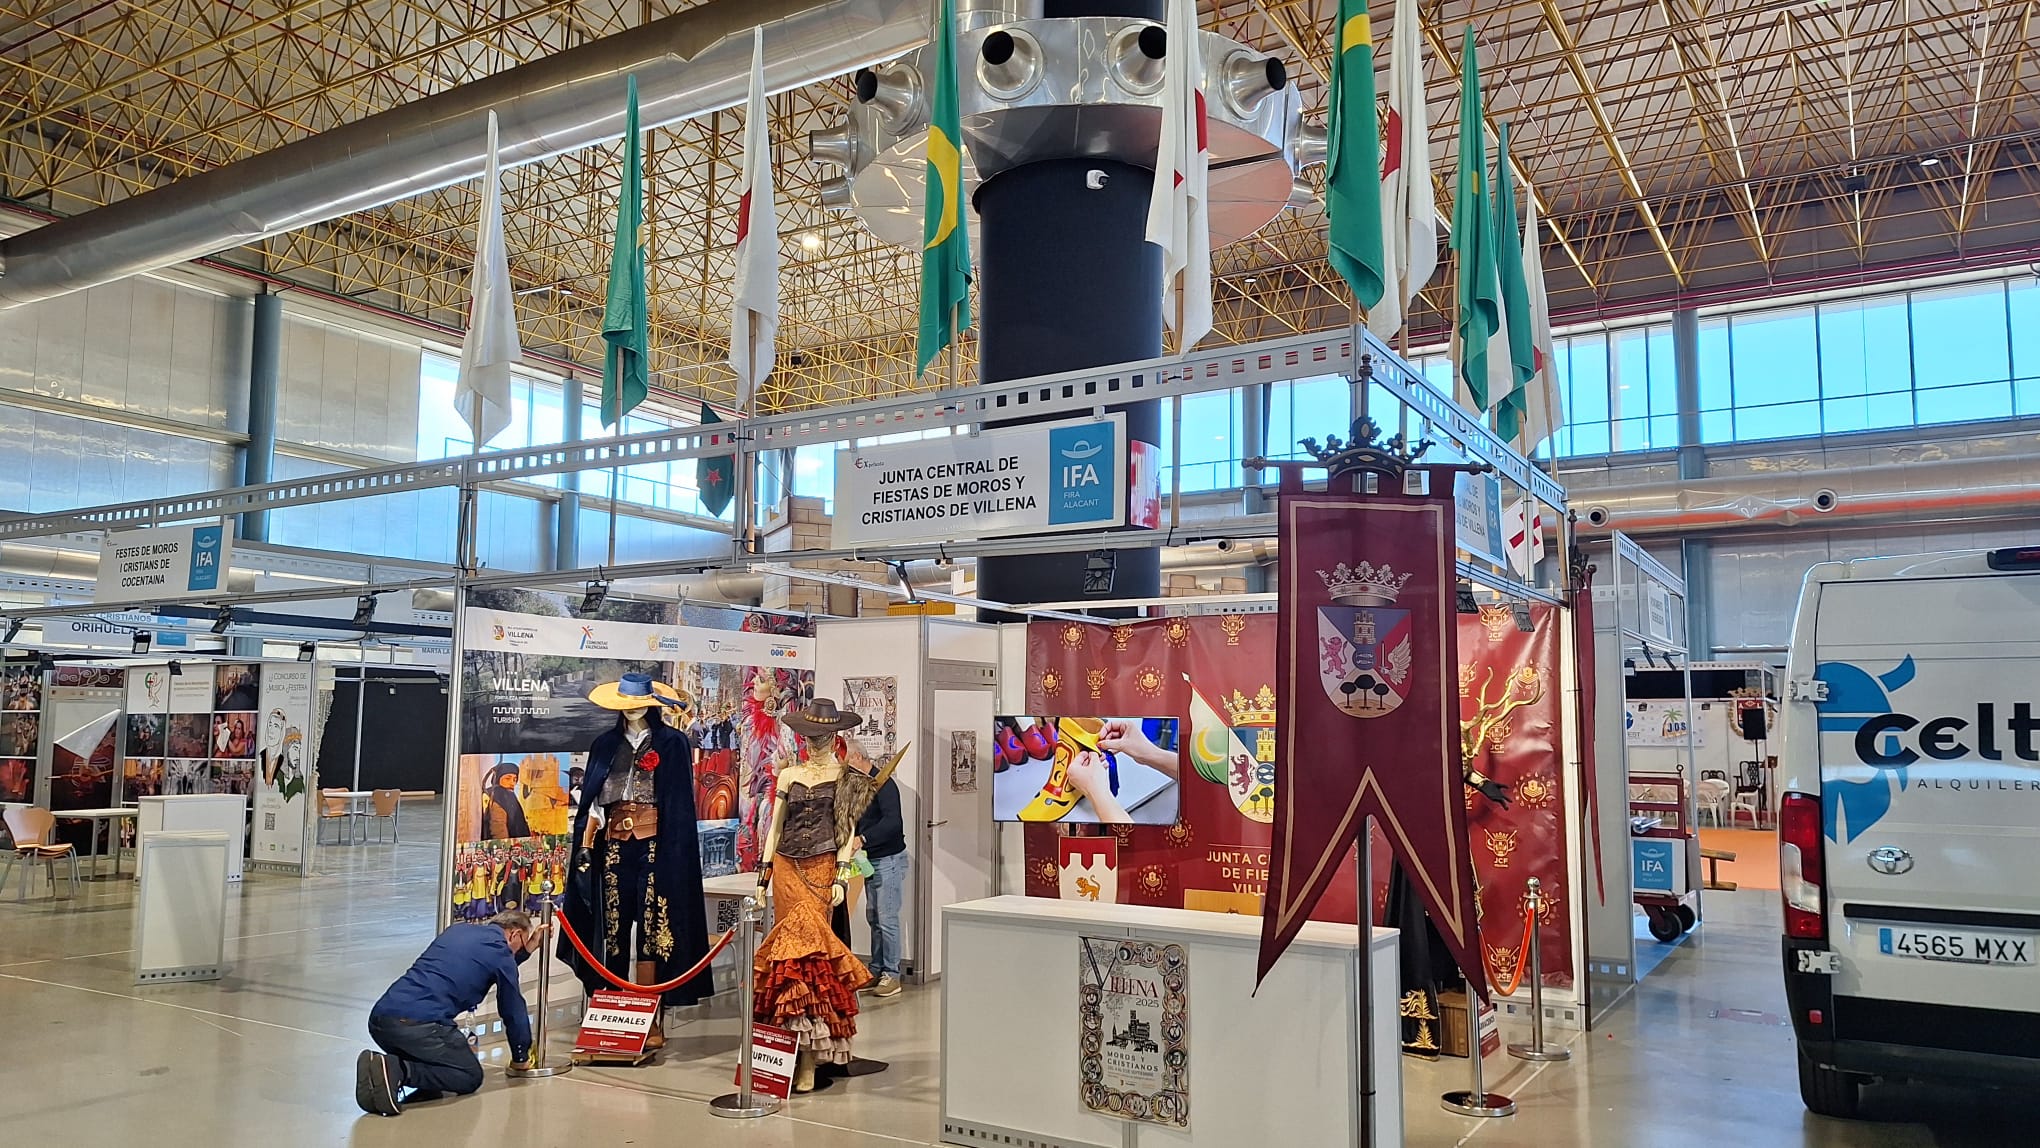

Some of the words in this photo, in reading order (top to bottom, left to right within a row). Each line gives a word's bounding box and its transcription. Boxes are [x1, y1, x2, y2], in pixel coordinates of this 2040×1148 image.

[879, 468, 923, 485] JUNTA
[927, 459, 994, 479] CENTRAL
[999, 456, 1019, 471] DE
[1063, 463, 1100, 488] IFA
[873, 486, 929, 505] FIESTAS
[933, 484, 953, 498] DE
[956, 477, 1011, 496] MOROS
[1015, 476, 1026, 489] Y
[1063, 491, 1081, 499] FIRA
[861, 505, 946, 525] CRISTIANOS
[950, 502, 969, 517] DE
[974, 495, 1036, 514] VILLENA
[1063, 498, 1100, 509] ALACANT
[115, 546, 140, 559] FESTES
[141, 545, 151, 556] DE
[152, 542, 179, 555] MOROS
[195, 551, 213, 567] IFA
[124, 559, 159, 573] CRISTIANS
[160, 559, 170, 569] DE
[121, 574, 165, 587] COCENTAINA
[100, 613, 152, 623] CRISTIANOS
[507, 631, 534, 639] VILLENA
[492, 677, 549, 692] VILLENA
[492, 716, 521, 724] TURISMO
[1490, 743, 1504, 751] JCF
[1918, 778, 2040, 791] ALQUILER
[1206, 850, 1252, 865] JUNTA
[1257, 853, 1271, 865] C
[1494, 857, 1509, 865] JCF
[1641, 860, 1664, 873] IFA
[1222, 866, 1240, 879] DE
[1246, 868, 1269, 881] FIE
[1897, 933, 1964, 957] 4565
[1975, 937, 2028, 962] MXX
[1135, 997, 1159, 1008] 2025
[589, 1013, 598, 1021] EL
[601, 1014, 647, 1026] PERNALES
[752, 1050, 784, 1067] URTIVAS
[1107, 1051, 1136, 1062] MOROS
[1107, 1057, 1159, 1072] CRISTIANOS
